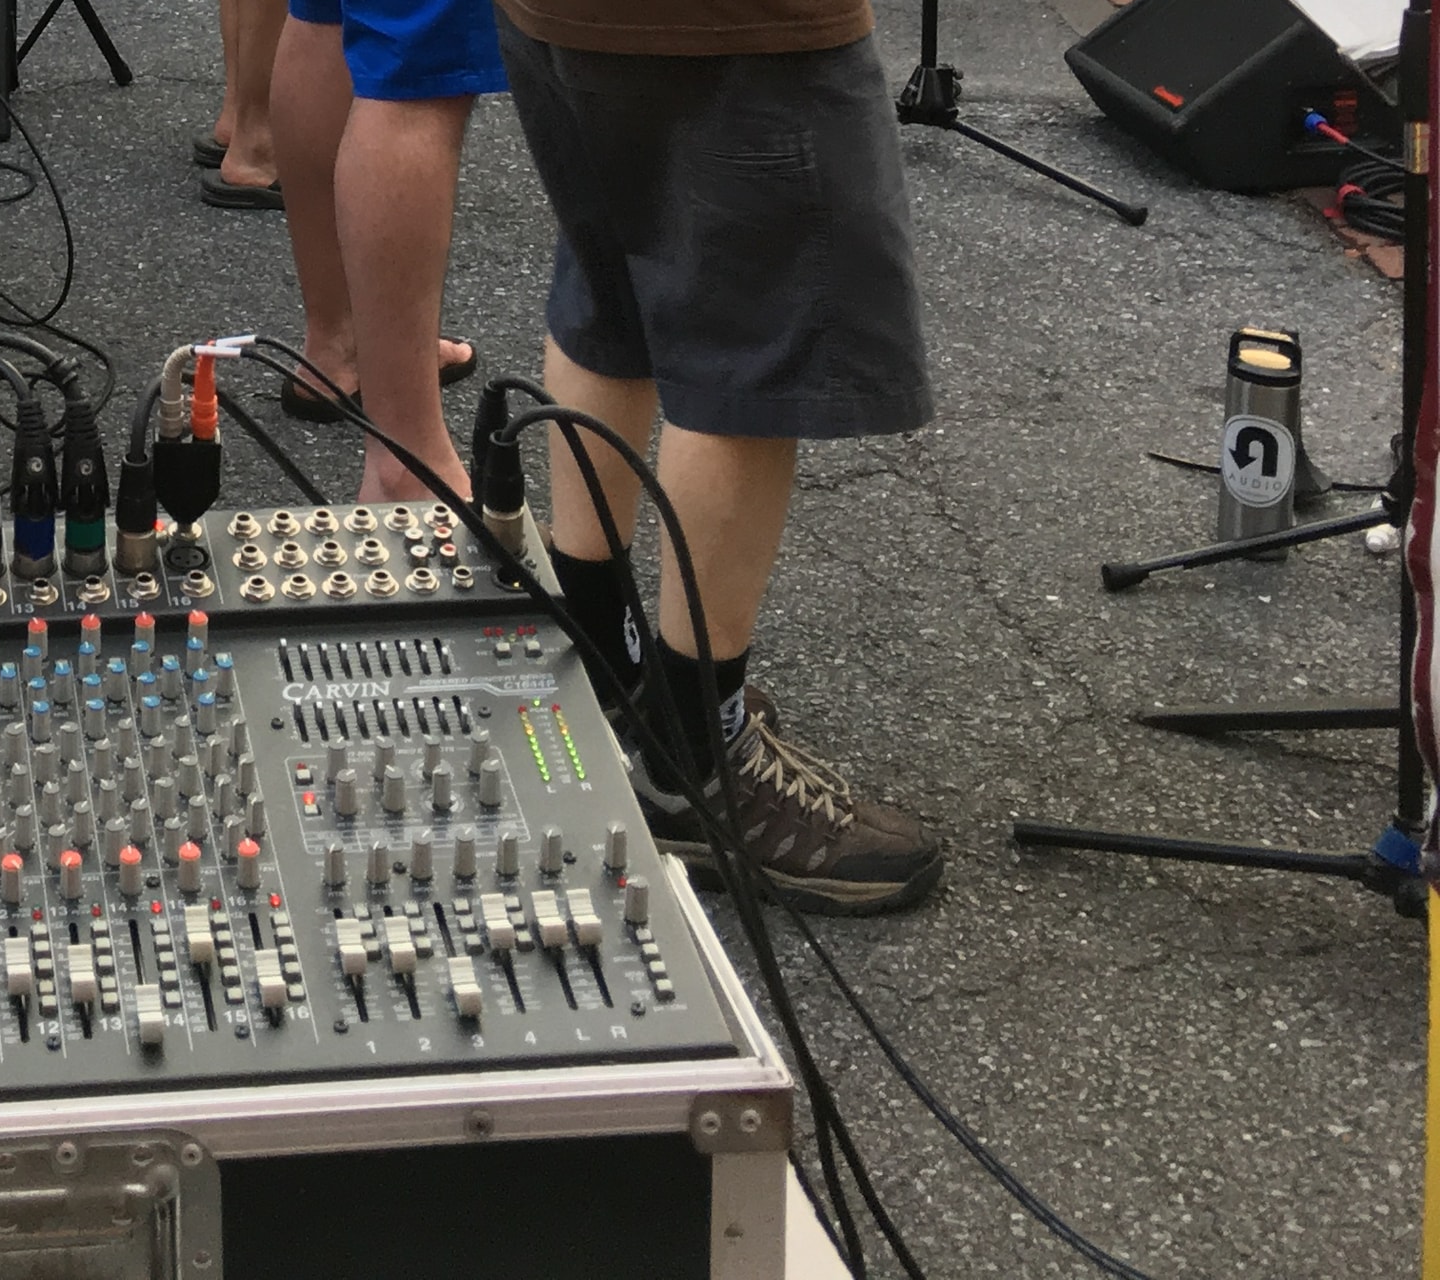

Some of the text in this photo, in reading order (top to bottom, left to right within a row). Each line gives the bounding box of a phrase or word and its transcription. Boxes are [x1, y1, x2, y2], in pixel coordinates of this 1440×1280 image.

[1228, 473, 1282, 491] AUDIO
[15, 603, 35, 614] 13
[67, 601, 87, 612] 14
[119, 598, 139, 609] 15
[171, 596, 192, 607] 16
[282, 681, 391, 701] CARVIN
[545, 784, 557, 794] L
[49, 906, 68, 917] 13
[109, 902, 128, 913] 14
[227, 896, 247, 907] 16
[36, 1020, 59, 1035] 12
[99, 1016, 123, 1031] 13
[224, 1009, 248, 1024] 15
[286, 1005, 310, 1020] 16
[365, 1040, 377, 1054] 1
[418, 1037, 432, 1052] 2
[472, 1033, 484, 1048] 3
[575, 1027, 591, 1041] L
[610, 1025, 628, 1039] R
